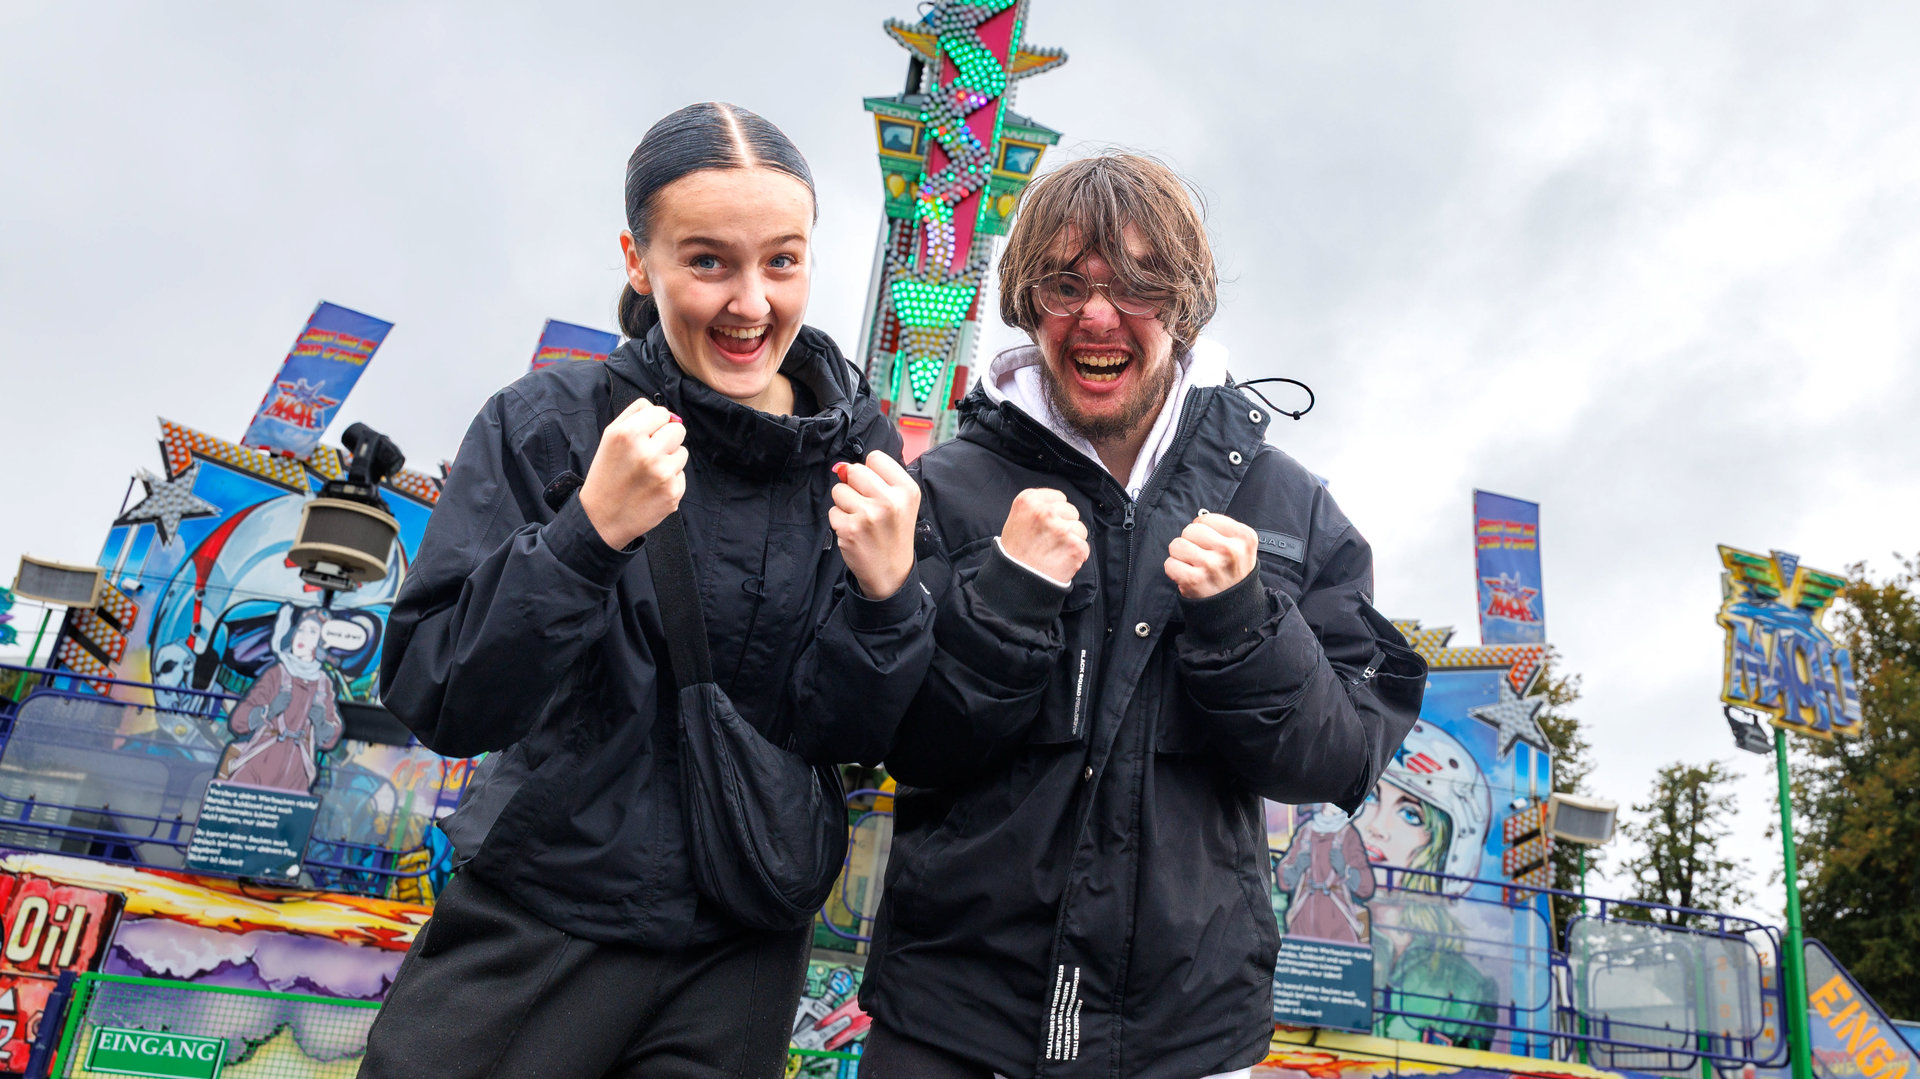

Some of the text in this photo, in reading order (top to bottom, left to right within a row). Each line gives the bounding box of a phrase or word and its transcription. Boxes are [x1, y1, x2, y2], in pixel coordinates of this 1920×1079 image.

[6, 896, 87, 968] Oil
[98, 1032, 218, 1061] EINGANG
[1054, 1025, 1063, 1060] PROJECTS
[1063, 1017, 1071, 1060] COLLECTION
